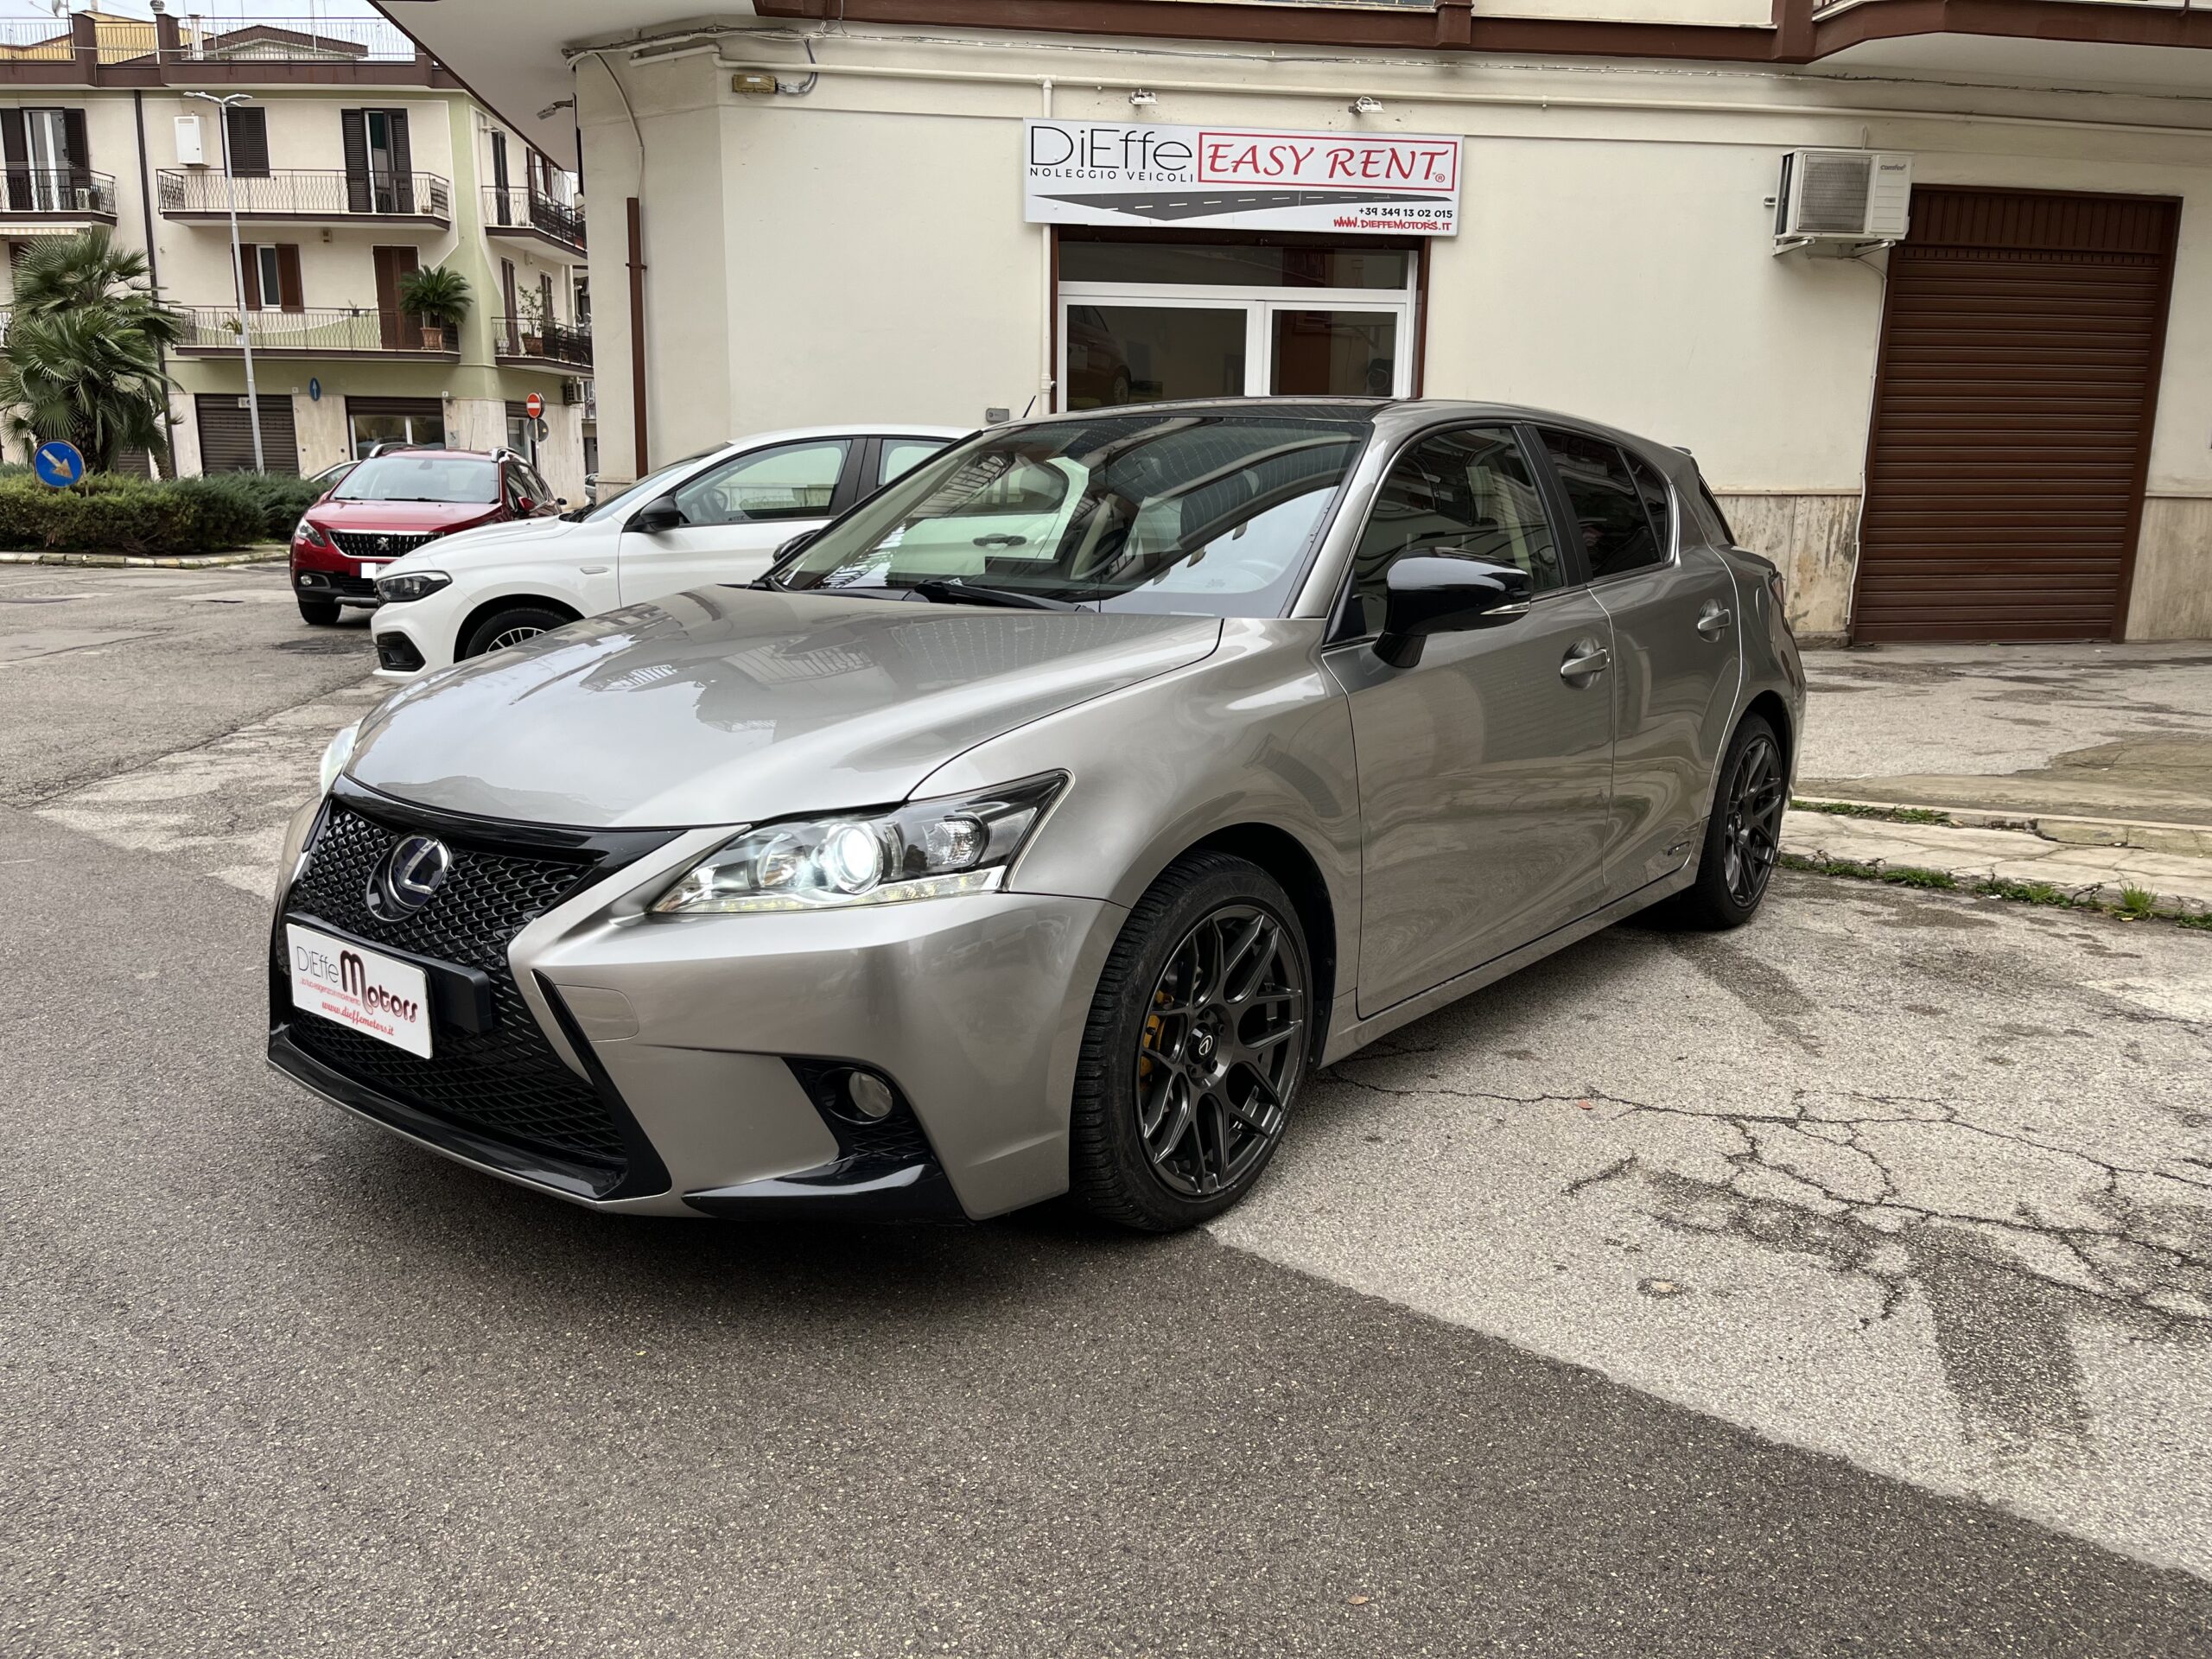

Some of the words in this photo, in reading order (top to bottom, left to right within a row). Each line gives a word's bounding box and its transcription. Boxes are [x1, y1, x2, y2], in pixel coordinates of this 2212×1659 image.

[1031, 125, 1192, 171] DiEffe
[1207, 143, 1315, 176] EASY
[1326, 147, 1449, 181] RENT
[1030, 167, 1116, 180] NOLEGGIO
[1127, 171, 1193, 182] VEICOLI
[1359, 207, 1378, 216] +39
[1381, 207, 1401, 217] 349
[1403, 208, 1414, 217] 13
[1417, 209, 1431, 218] 02
[1434, 210, 1453, 219] 015
[296, 945, 340, 983] DiEffe
[321, 1001, 395, 1036] www.dieffemotors.it
